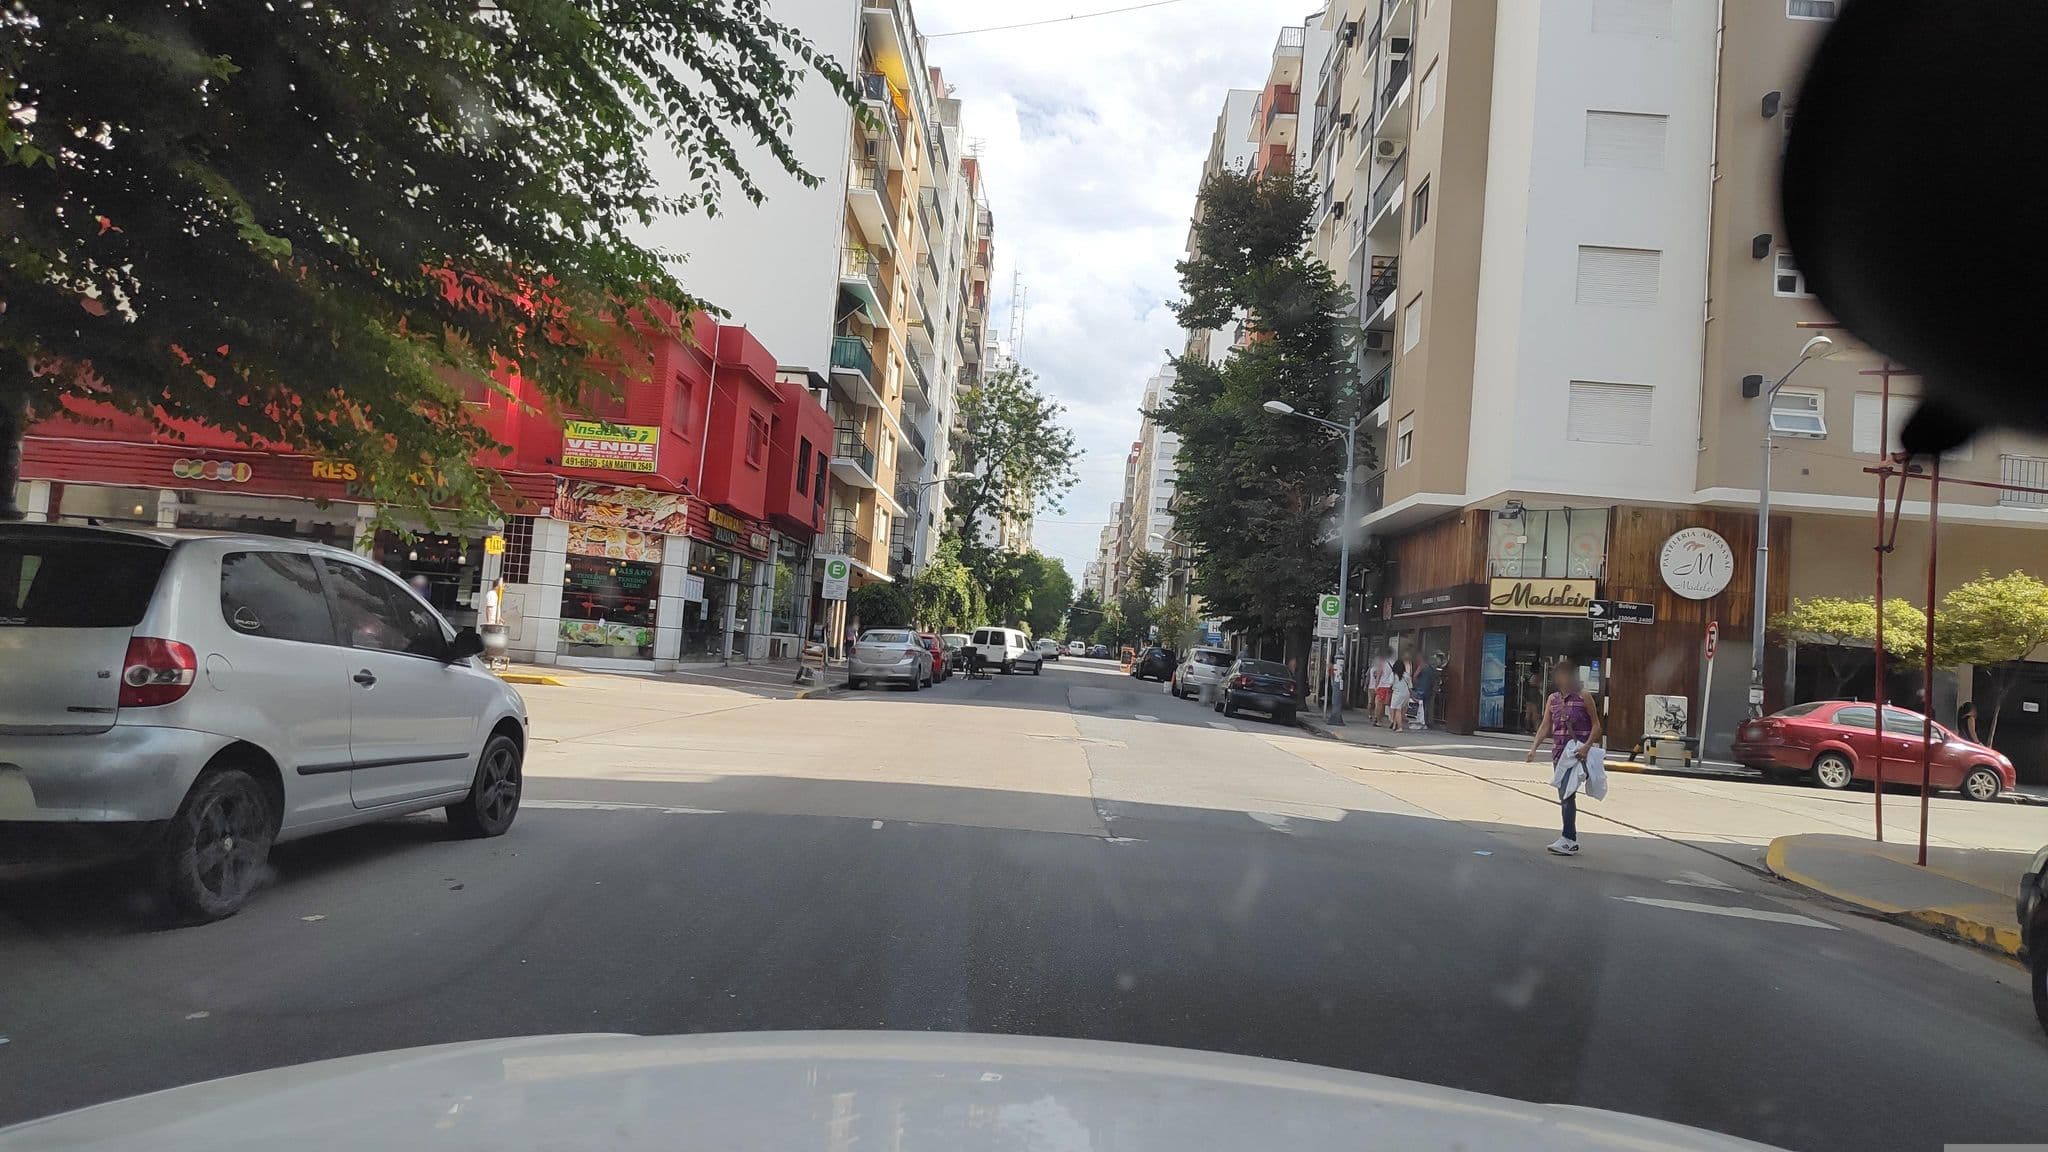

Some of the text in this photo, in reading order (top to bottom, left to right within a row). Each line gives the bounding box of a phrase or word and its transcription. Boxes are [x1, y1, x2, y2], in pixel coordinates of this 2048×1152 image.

[567, 438, 654, 454] VENDE
[565, 456, 598, 467] 491-6850
[602, 459, 613, 469] SAN
[614, 461, 637, 471] MARTIN
[638, 462, 653, 471] 2649
[1662, 531, 1731, 570] PASTELERIA ARTESANAL
[1672, 552, 1714, 578] M
